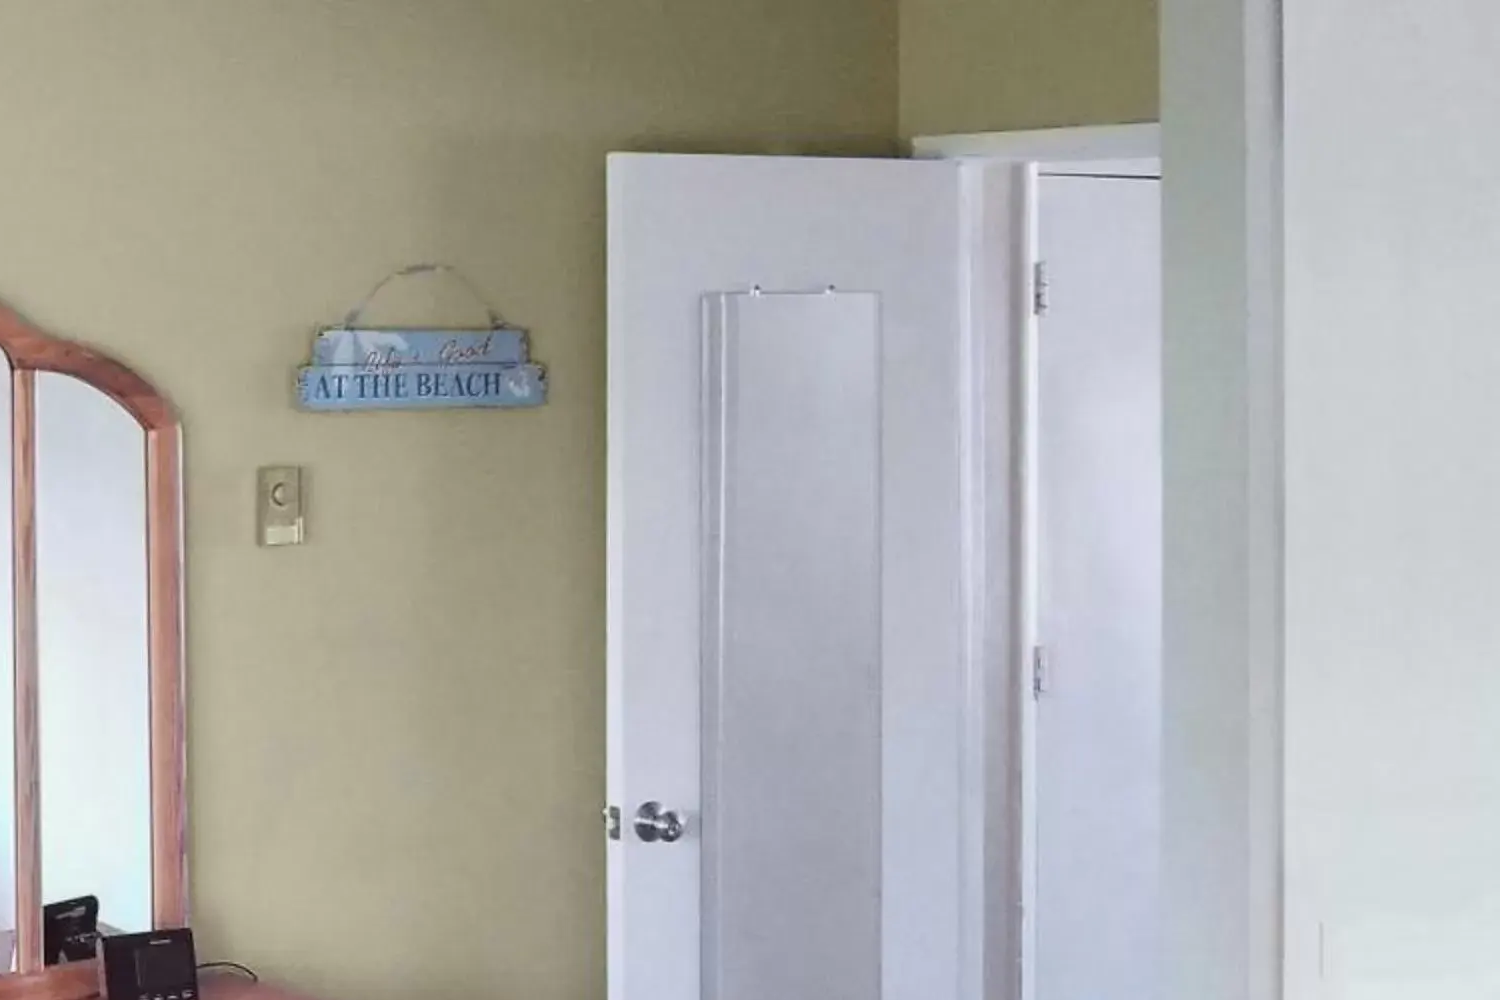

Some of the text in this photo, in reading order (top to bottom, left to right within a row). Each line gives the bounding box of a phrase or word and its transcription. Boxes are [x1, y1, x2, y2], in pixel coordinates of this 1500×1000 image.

[315, 371, 501, 400] AT THE BEACH
